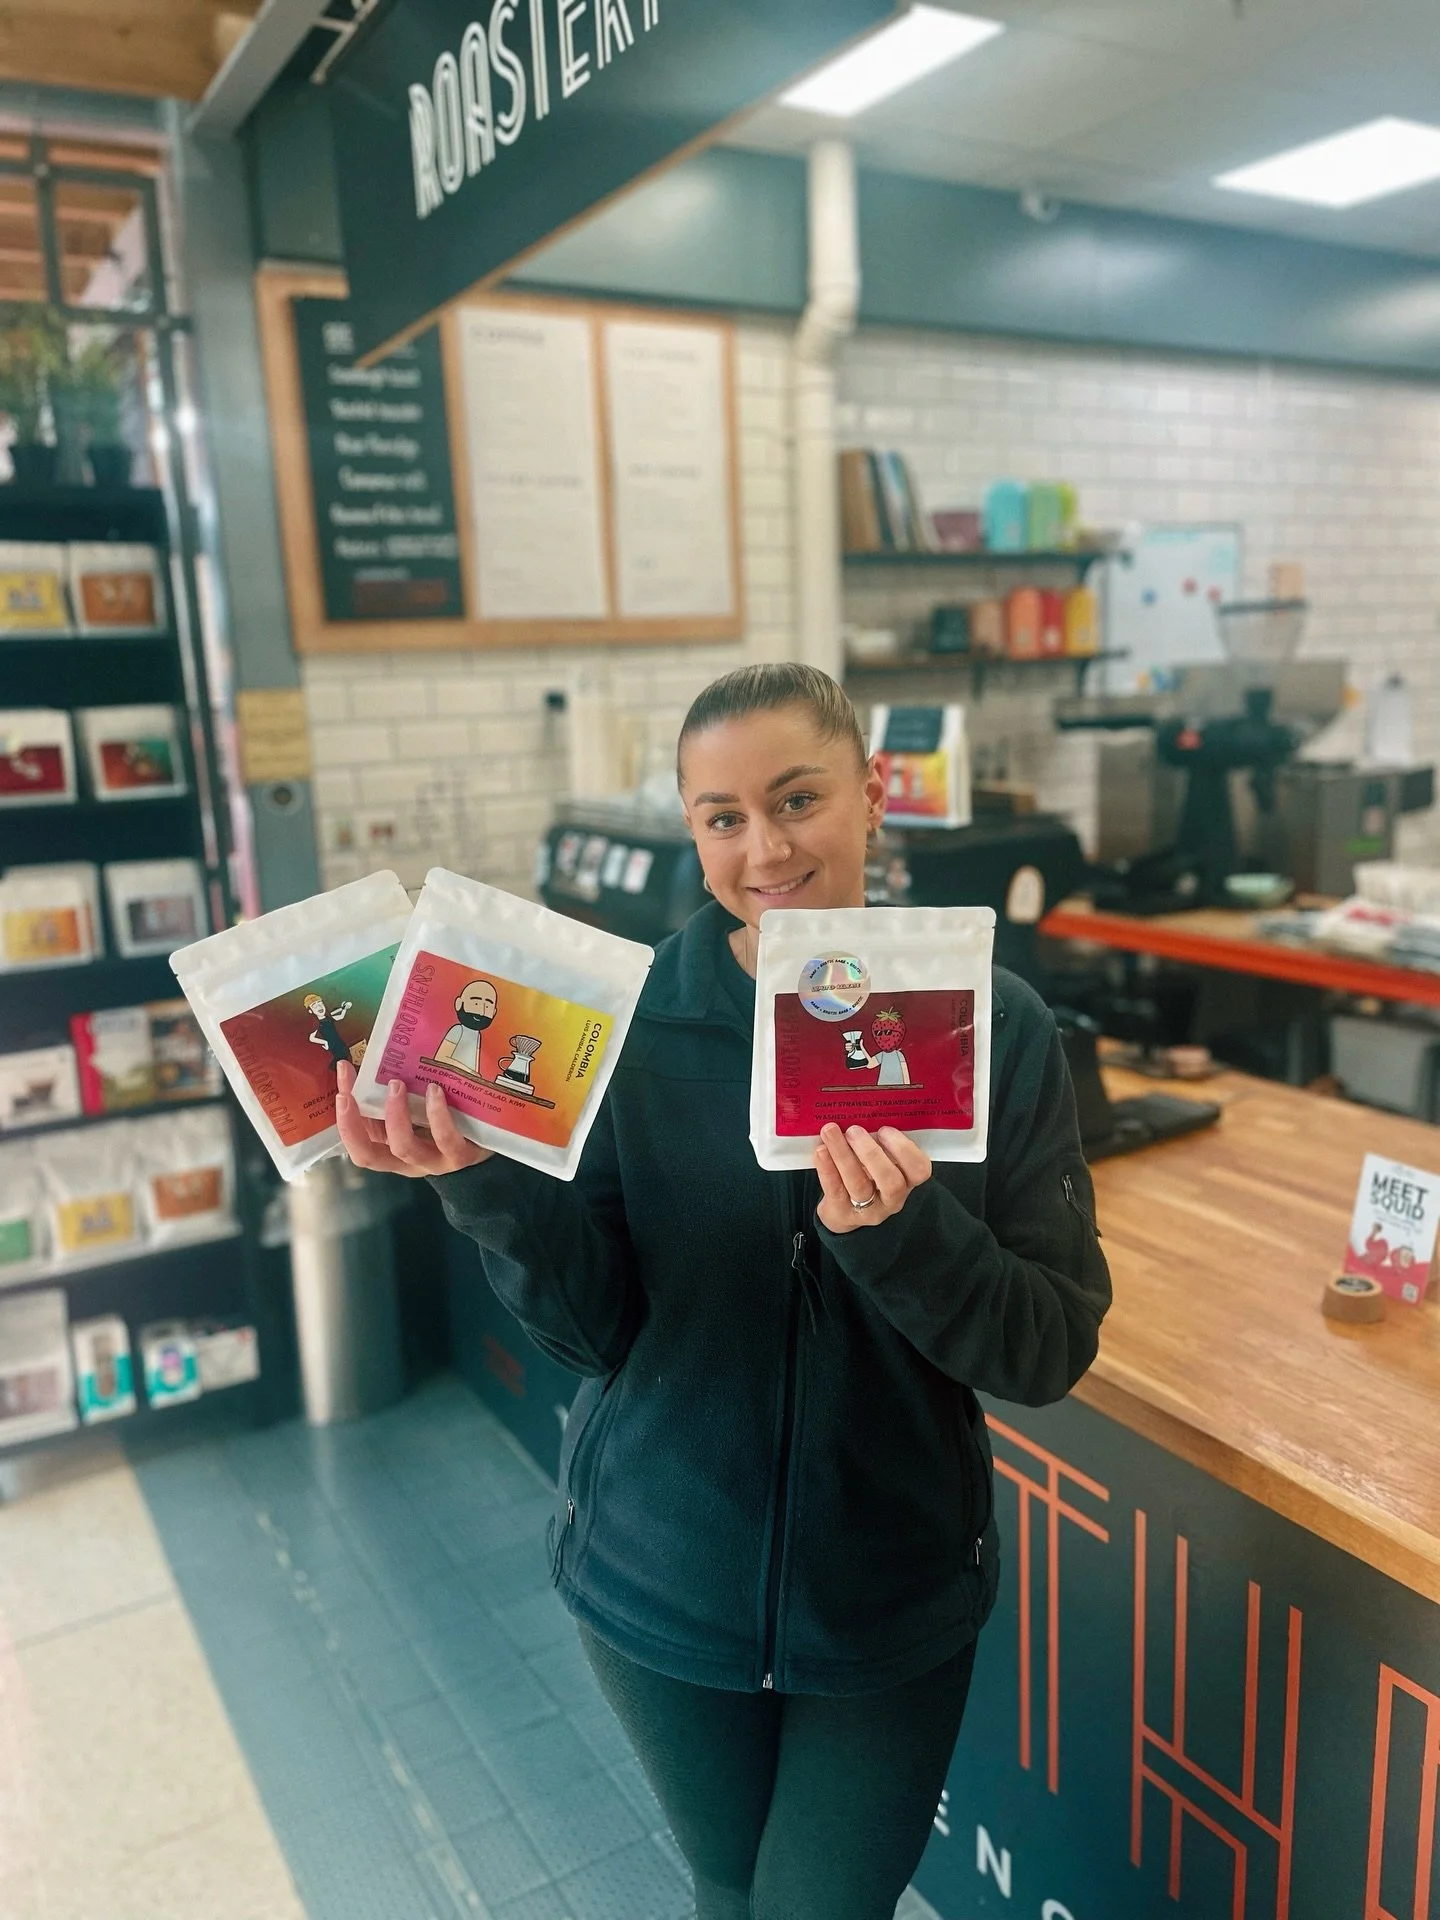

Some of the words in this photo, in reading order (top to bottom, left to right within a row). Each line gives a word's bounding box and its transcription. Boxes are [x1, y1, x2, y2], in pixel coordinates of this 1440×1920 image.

[408, 0, 659, 219] ROASTE
[392, 963, 436, 1046] BROTHERS
[380, 1047, 406, 1079] TWO
[576, 1023, 602, 1079] COLOMBIA
[303, 1095, 326, 1109] GREEN
[418, 1065, 437, 1074] PEAR
[438, 1070, 463, 1084] DROPS,
[464, 1081, 484, 1093] FRUIT
[509, 1099, 526, 1109] KIWI
[451, 1088, 481, 1105] CATURRA
[486, 1103, 502, 1113] 1500
[269, 1105, 298, 1136] TWO
[309, 1106, 329, 1119] FULLY
[1372, 1172, 1429, 1204] MEET
[1369, 1190, 1425, 1220] SQUID
